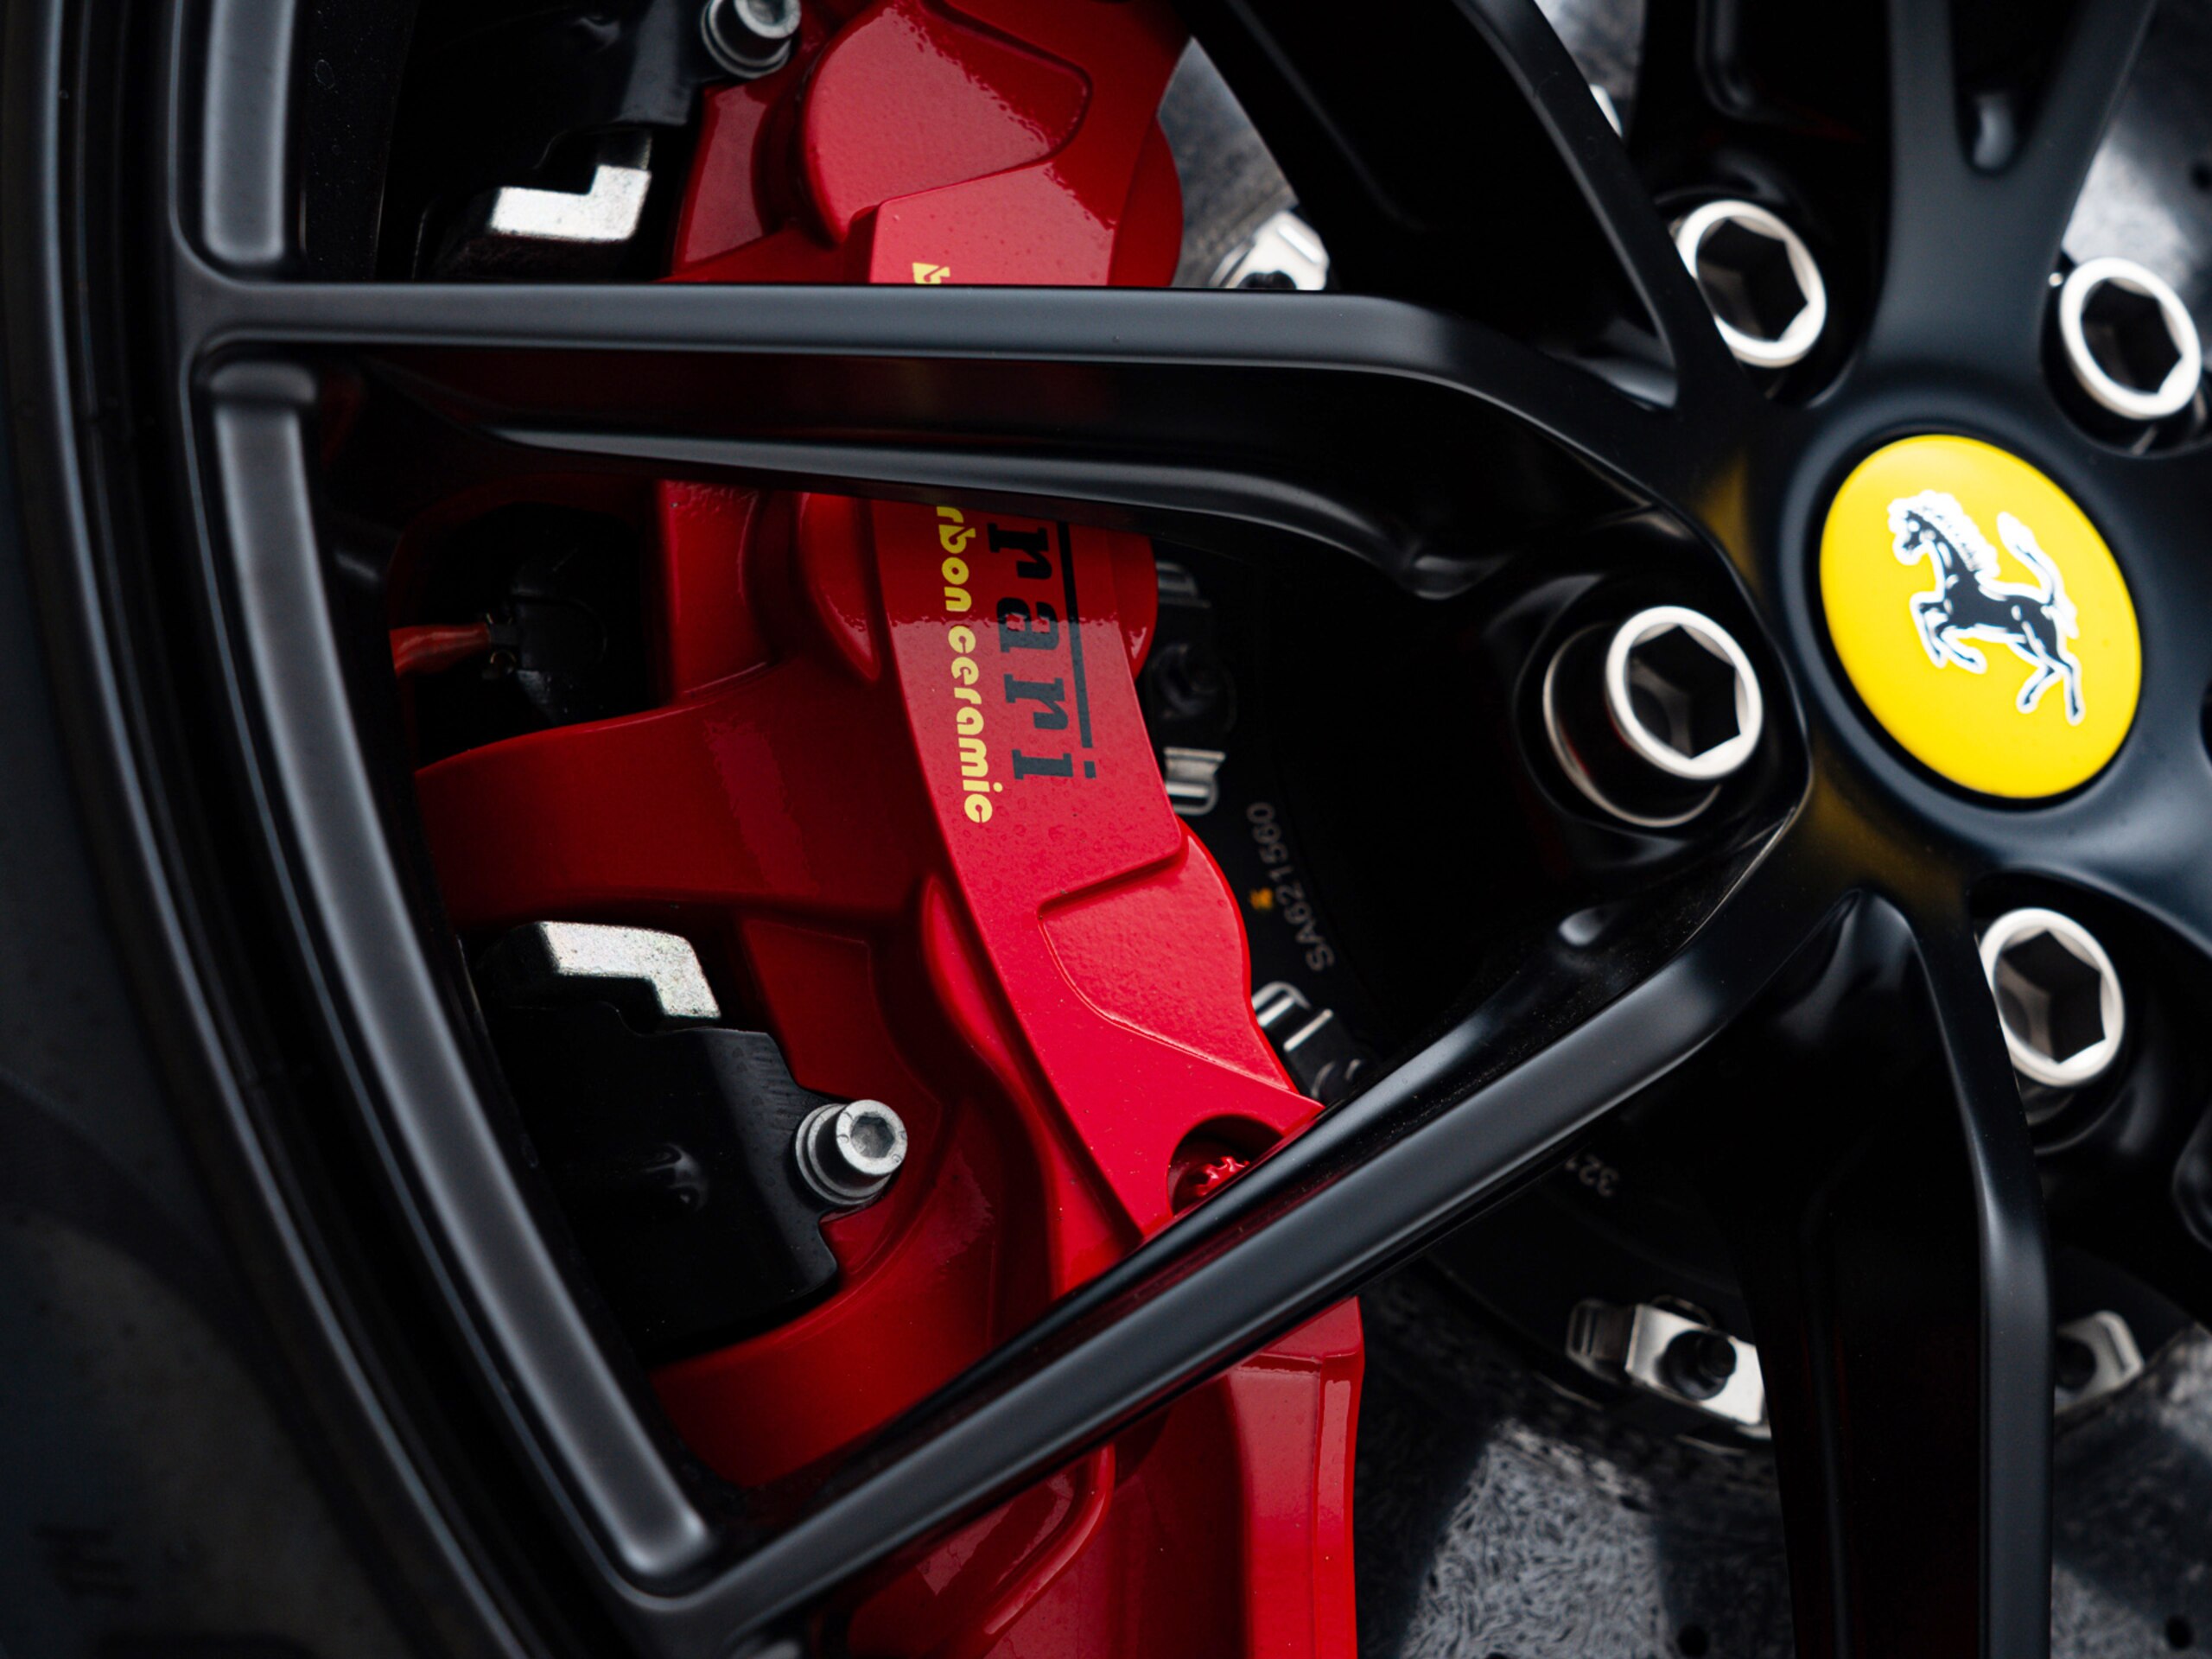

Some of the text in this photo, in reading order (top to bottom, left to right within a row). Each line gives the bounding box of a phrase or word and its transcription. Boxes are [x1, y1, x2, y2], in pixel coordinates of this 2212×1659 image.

[937, 506, 1003, 823] rbon ceramic
[987, 522, 1096, 779] rari
